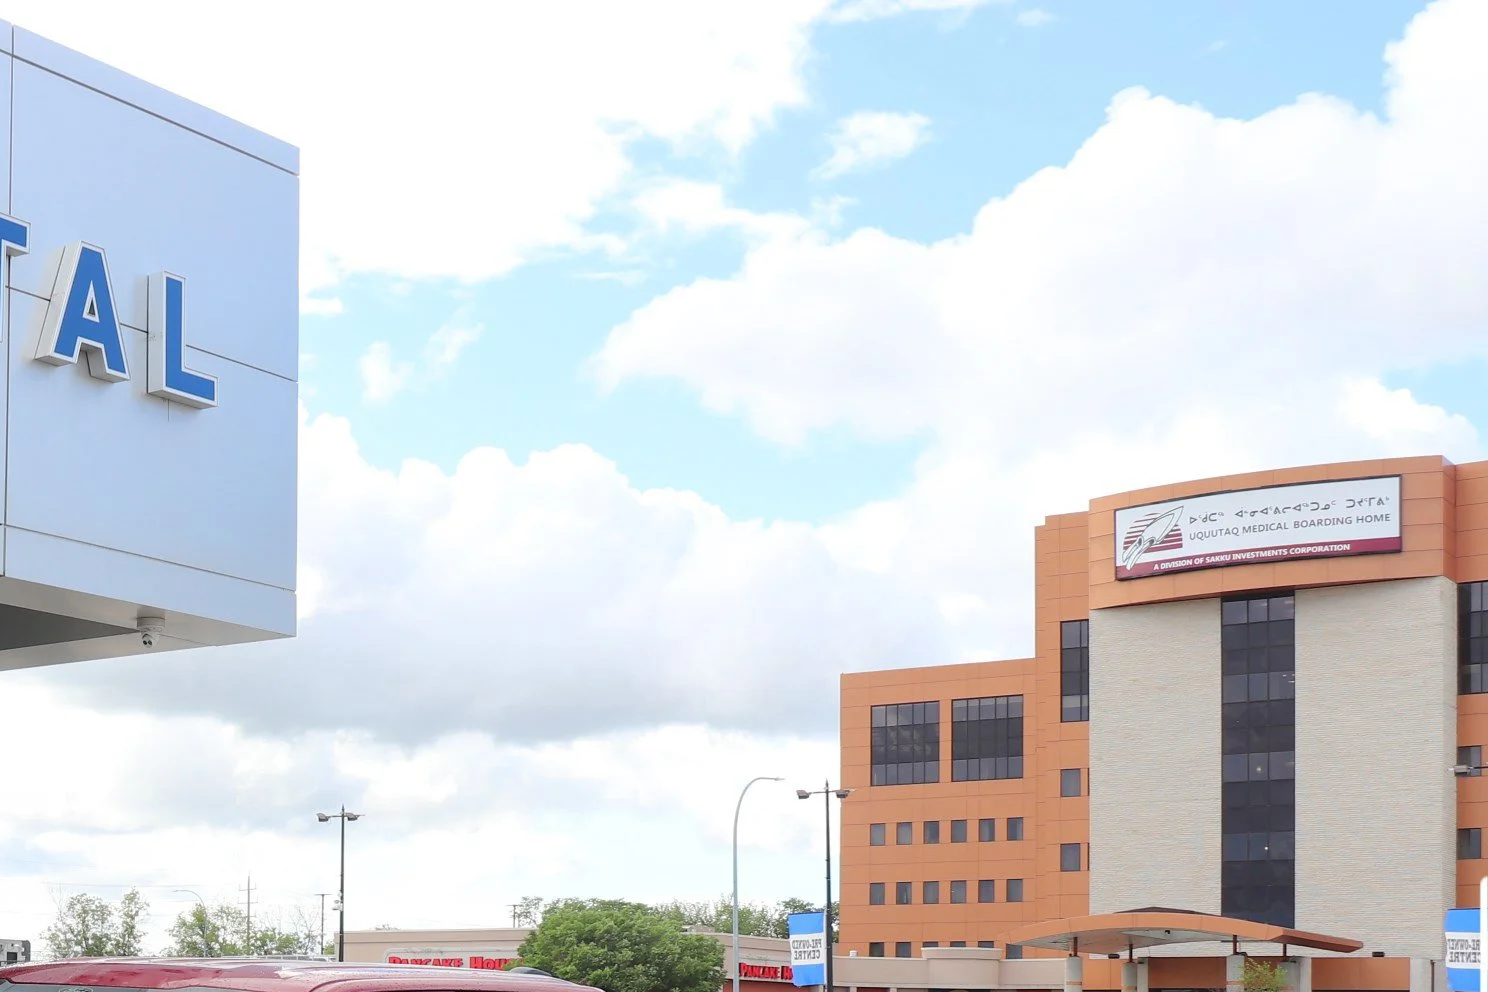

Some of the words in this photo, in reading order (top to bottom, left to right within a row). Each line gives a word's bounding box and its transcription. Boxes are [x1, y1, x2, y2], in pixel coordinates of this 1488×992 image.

[1189, 526, 1239, 541] UQUUTAQ
[1242, 521, 1289, 534] MEDICAL
[1293, 516, 1353, 529] BOARDING
[1356, 513, 1391, 524] HOME
[1153, 563, 1159, 571] A
[1160, 559, 1192, 570] DIVISION
[1194, 557, 1204, 565] OF
[1205, 554, 1231, 564] SAKKU
[1232, 547, 1288, 561] INVESTMENTS
[1289, 543, 1351, 555] CORPORATION
